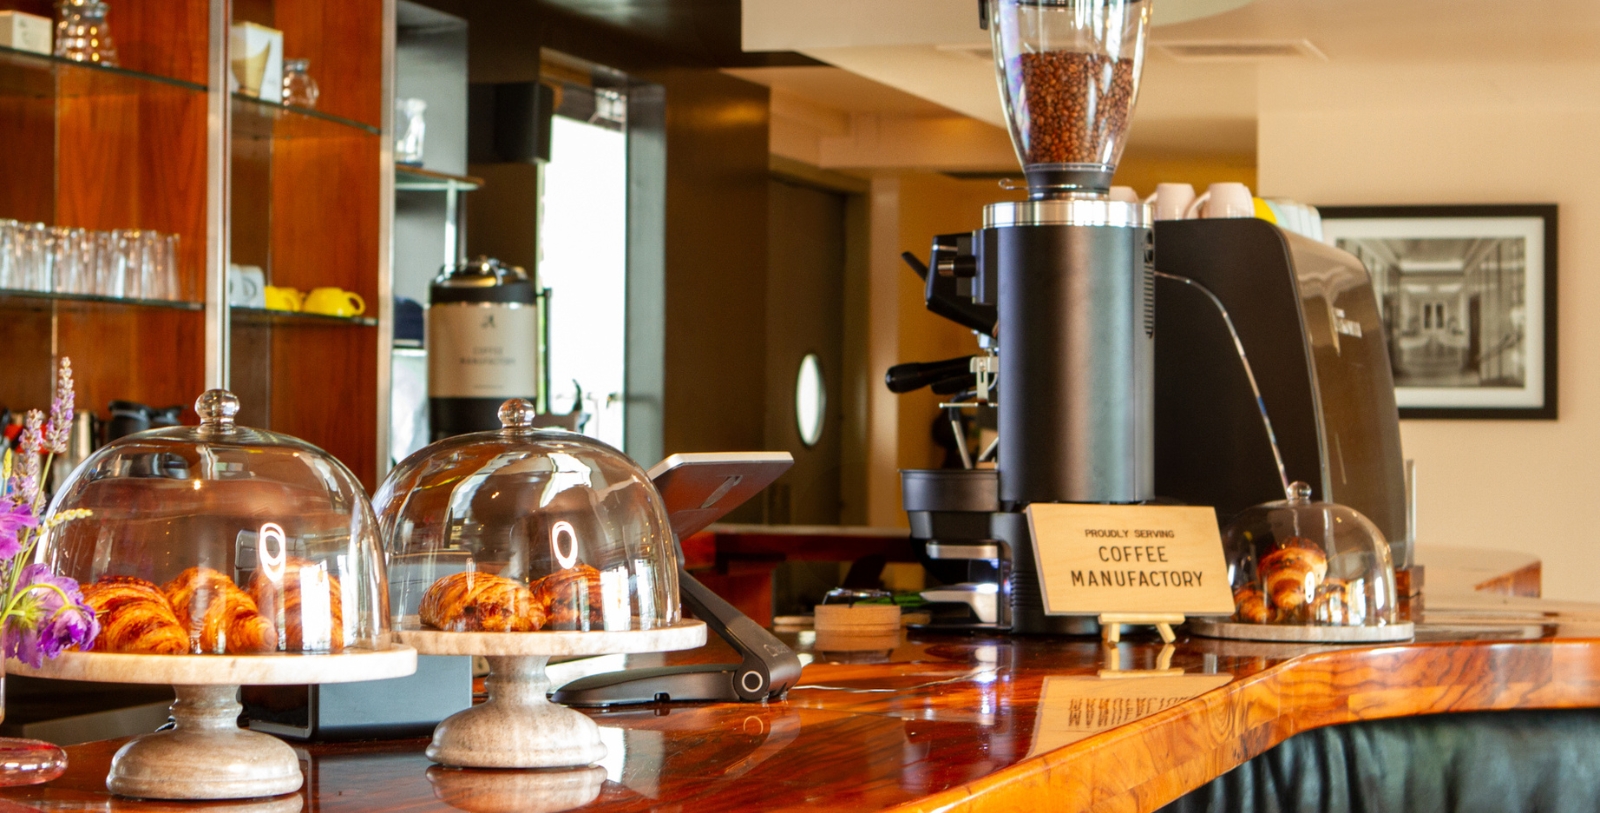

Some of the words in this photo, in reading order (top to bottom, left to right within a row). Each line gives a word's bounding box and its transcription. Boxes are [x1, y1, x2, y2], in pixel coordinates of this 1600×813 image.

[1084, 529, 1129, 538] PROUDLY
[1134, 529, 1175, 539] SERVING
[1098, 546, 1169, 562] COFFEE
[1070, 570, 1203, 587] MANUFACTORY
